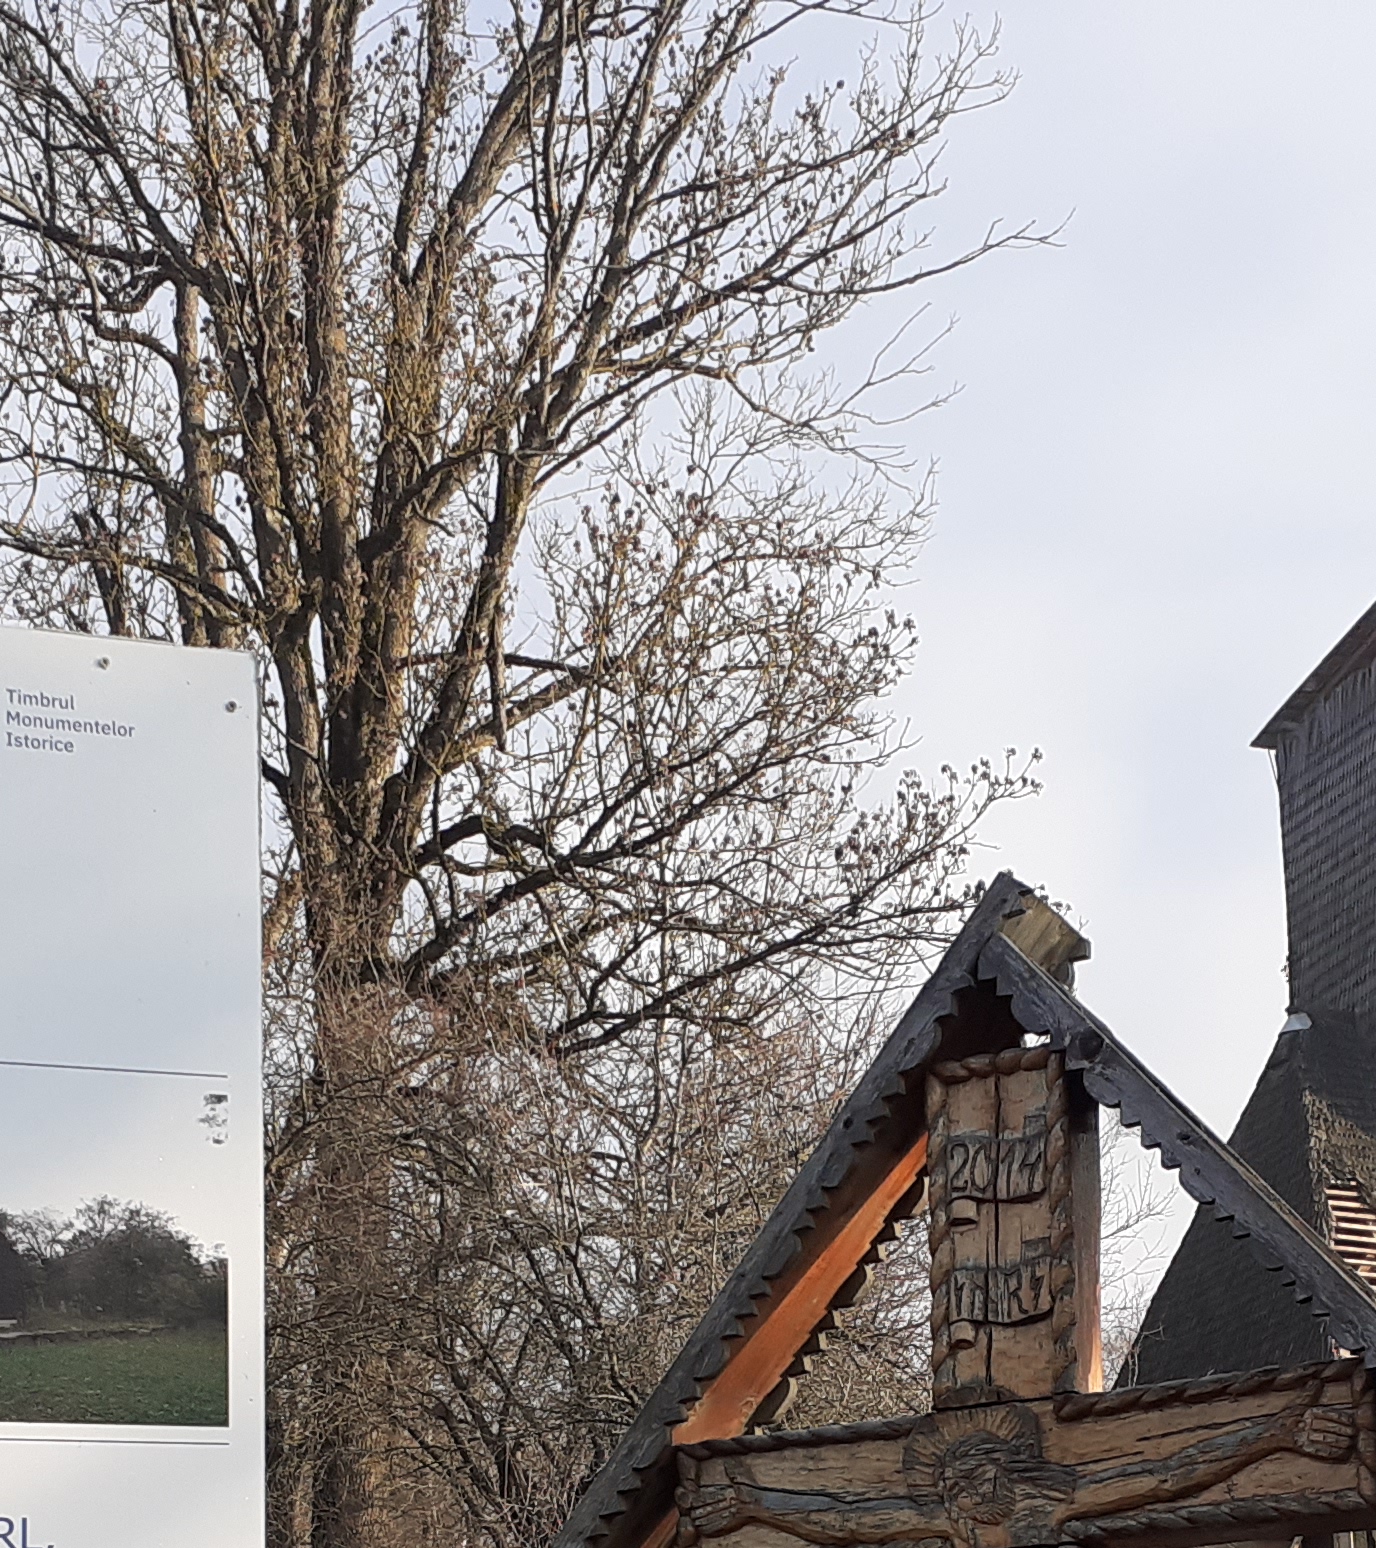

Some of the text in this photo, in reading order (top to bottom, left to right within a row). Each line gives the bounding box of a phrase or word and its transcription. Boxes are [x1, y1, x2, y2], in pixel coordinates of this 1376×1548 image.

[5, 688, 75, 711] Timbrul
[5, 710, 137, 739] Monumentelor
[6, 731, 74, 753] Istorice
